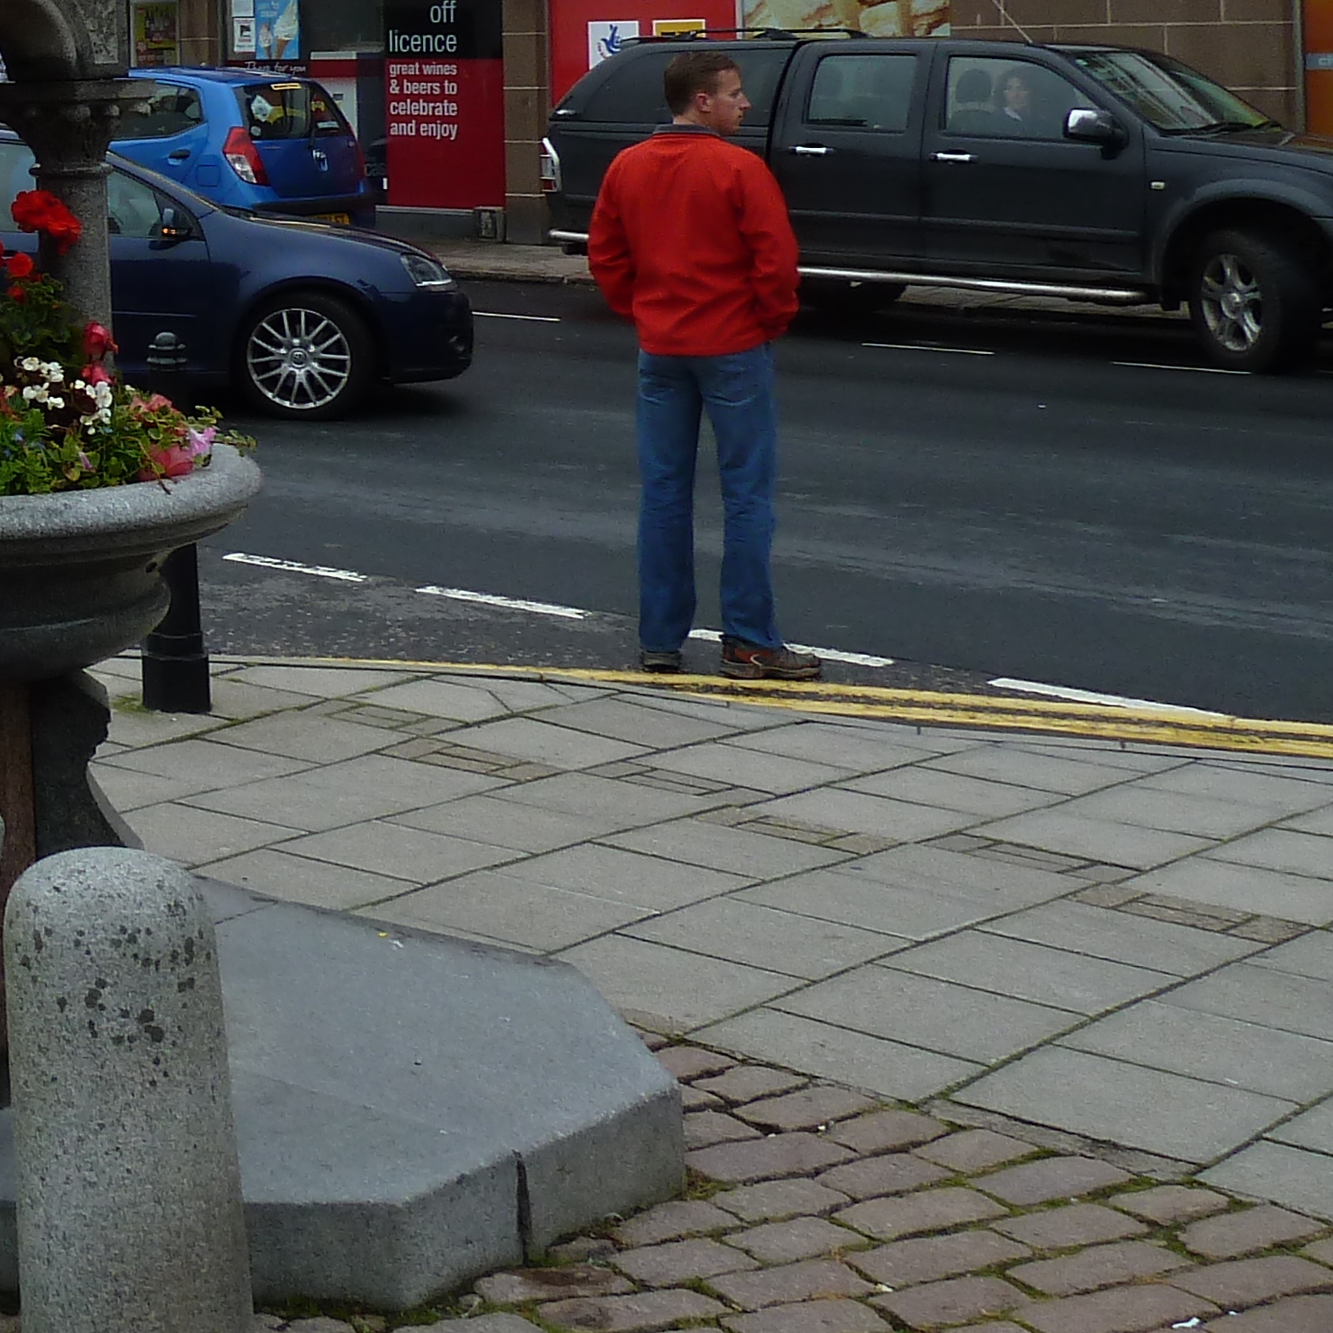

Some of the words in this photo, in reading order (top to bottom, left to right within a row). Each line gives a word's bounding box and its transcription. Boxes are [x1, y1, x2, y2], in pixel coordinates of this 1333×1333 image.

[430, 0, 457, 23] off
[388, 29, 458, 53] licence
[389, 62, 420, 77] great
[422, 62, 457, 75] wines
[389, 79, 400, 94] &
[403, 79, 440, 94] beers
[444, 80, 457, 94] to
[389, 99, 458, 116] celebrate
[389, 119, 416, 136] and
[420, 120, 458, 141] enjoy
